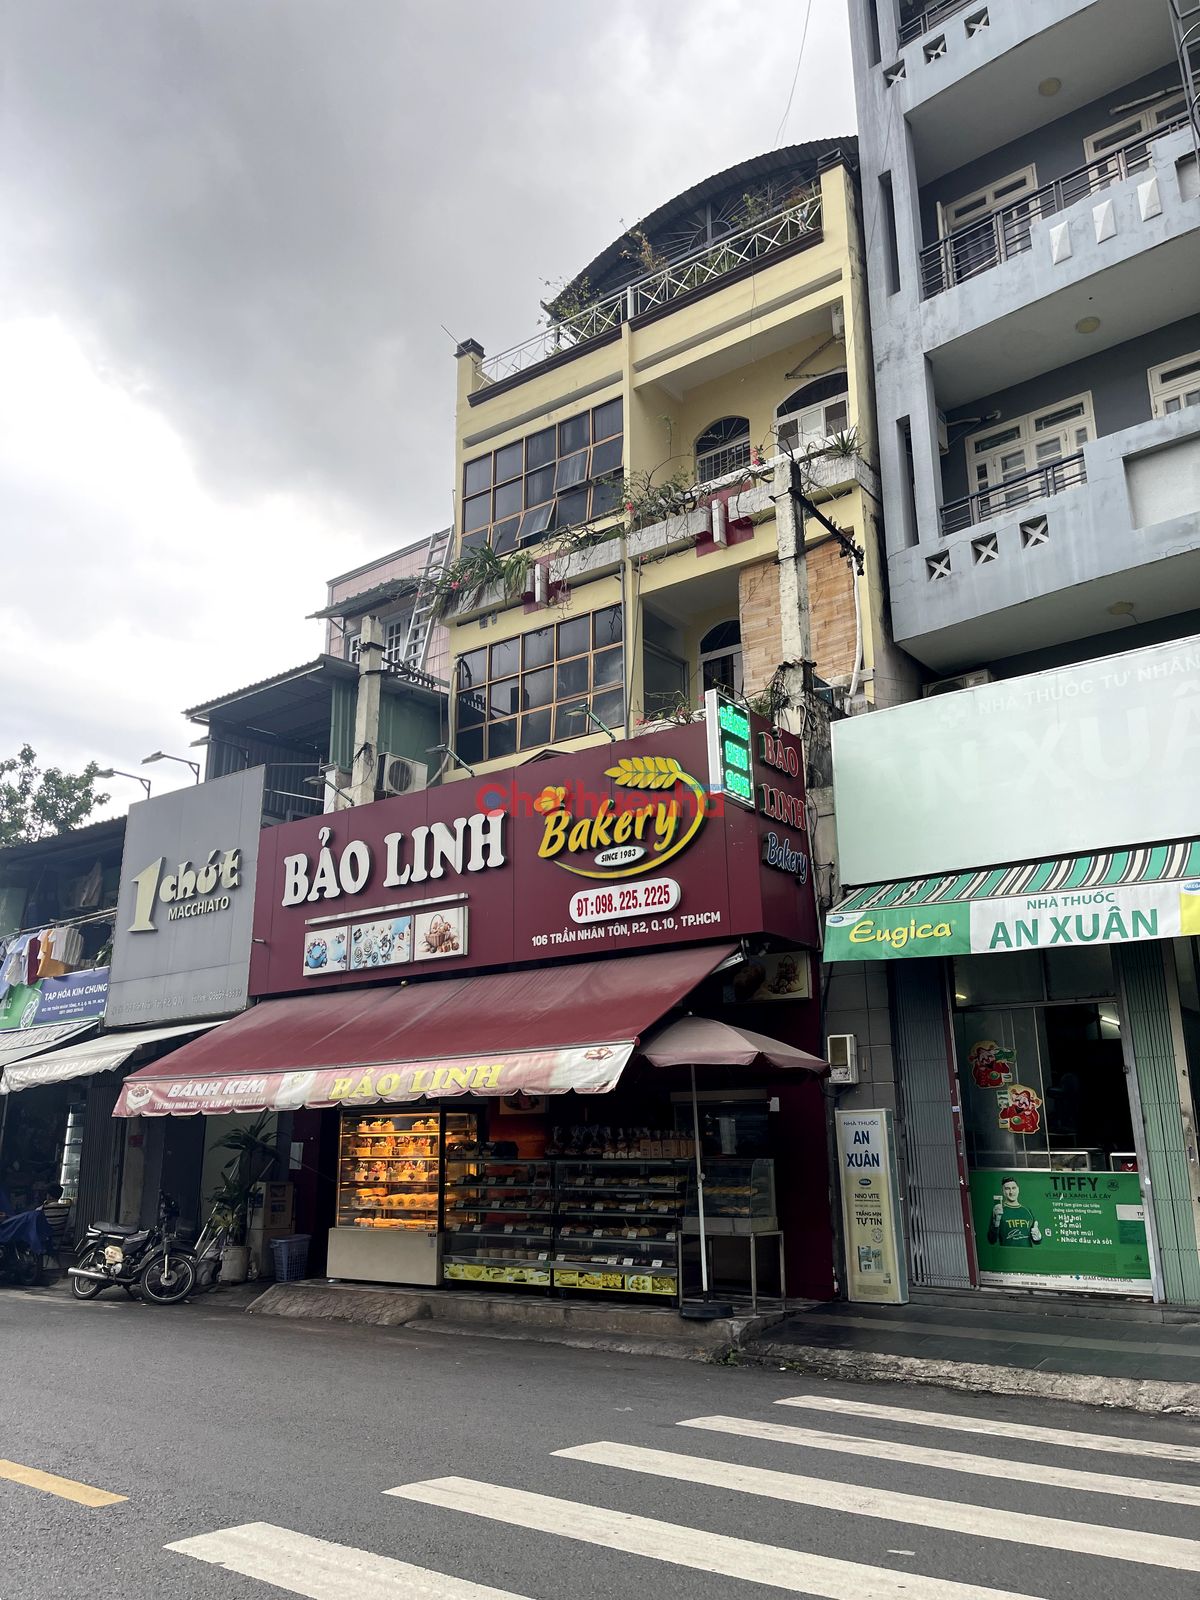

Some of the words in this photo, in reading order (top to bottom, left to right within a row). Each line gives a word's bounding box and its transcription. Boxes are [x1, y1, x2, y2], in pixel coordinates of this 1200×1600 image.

[762, 783, 806, 830] LINH
[537, 800, 678, 859] Bakery
[281, 827, 370, 907] BẢO
[383, 809, 505, 887] LINH
[601, 852, 618, 862] SINCE
[620, 849, 636, 859] 1983
[767, 832, 807, 884] Bakery
[128, 857, 164, 931] 1
[1027, 896, 1058, 910] NHÀ
[1061, 892, 1115, 907] THUỐC
[168, 896, 229, 921] MACCHIATO
[532, 935, 548, 946] 106
[550, 927, 576, 944] TRẦN
[577, 926, 605, 940] NHÂN
[607, 923, 630, 937] TÔN,
[681, 911, 721, 927] TP.HCM
[849, 918, 953, 948] Eugica
[989, 919, 1038, 949] AN
[1050, 905, 1158, 944] XUÂN
[72, 987, 84, 996] KIM
[85, 983, 107, 994] CHUNG
[167, 1080, 222, 1098] BÁNH
[223, 1079, 266, 1095] KEM
[328, 1067, 401, 1100] BẢO
[408, 1064, 504, 1093] LINH
[853, 1130, 870, 1145] AN
[846, 1150, 880, 1168] XUÂN
[1050, 1176, 1098, 1191] TIFFY
[869, 1218, 882, 1226] TIN
[1006, 1219, 1030, 1228] TIFFY
